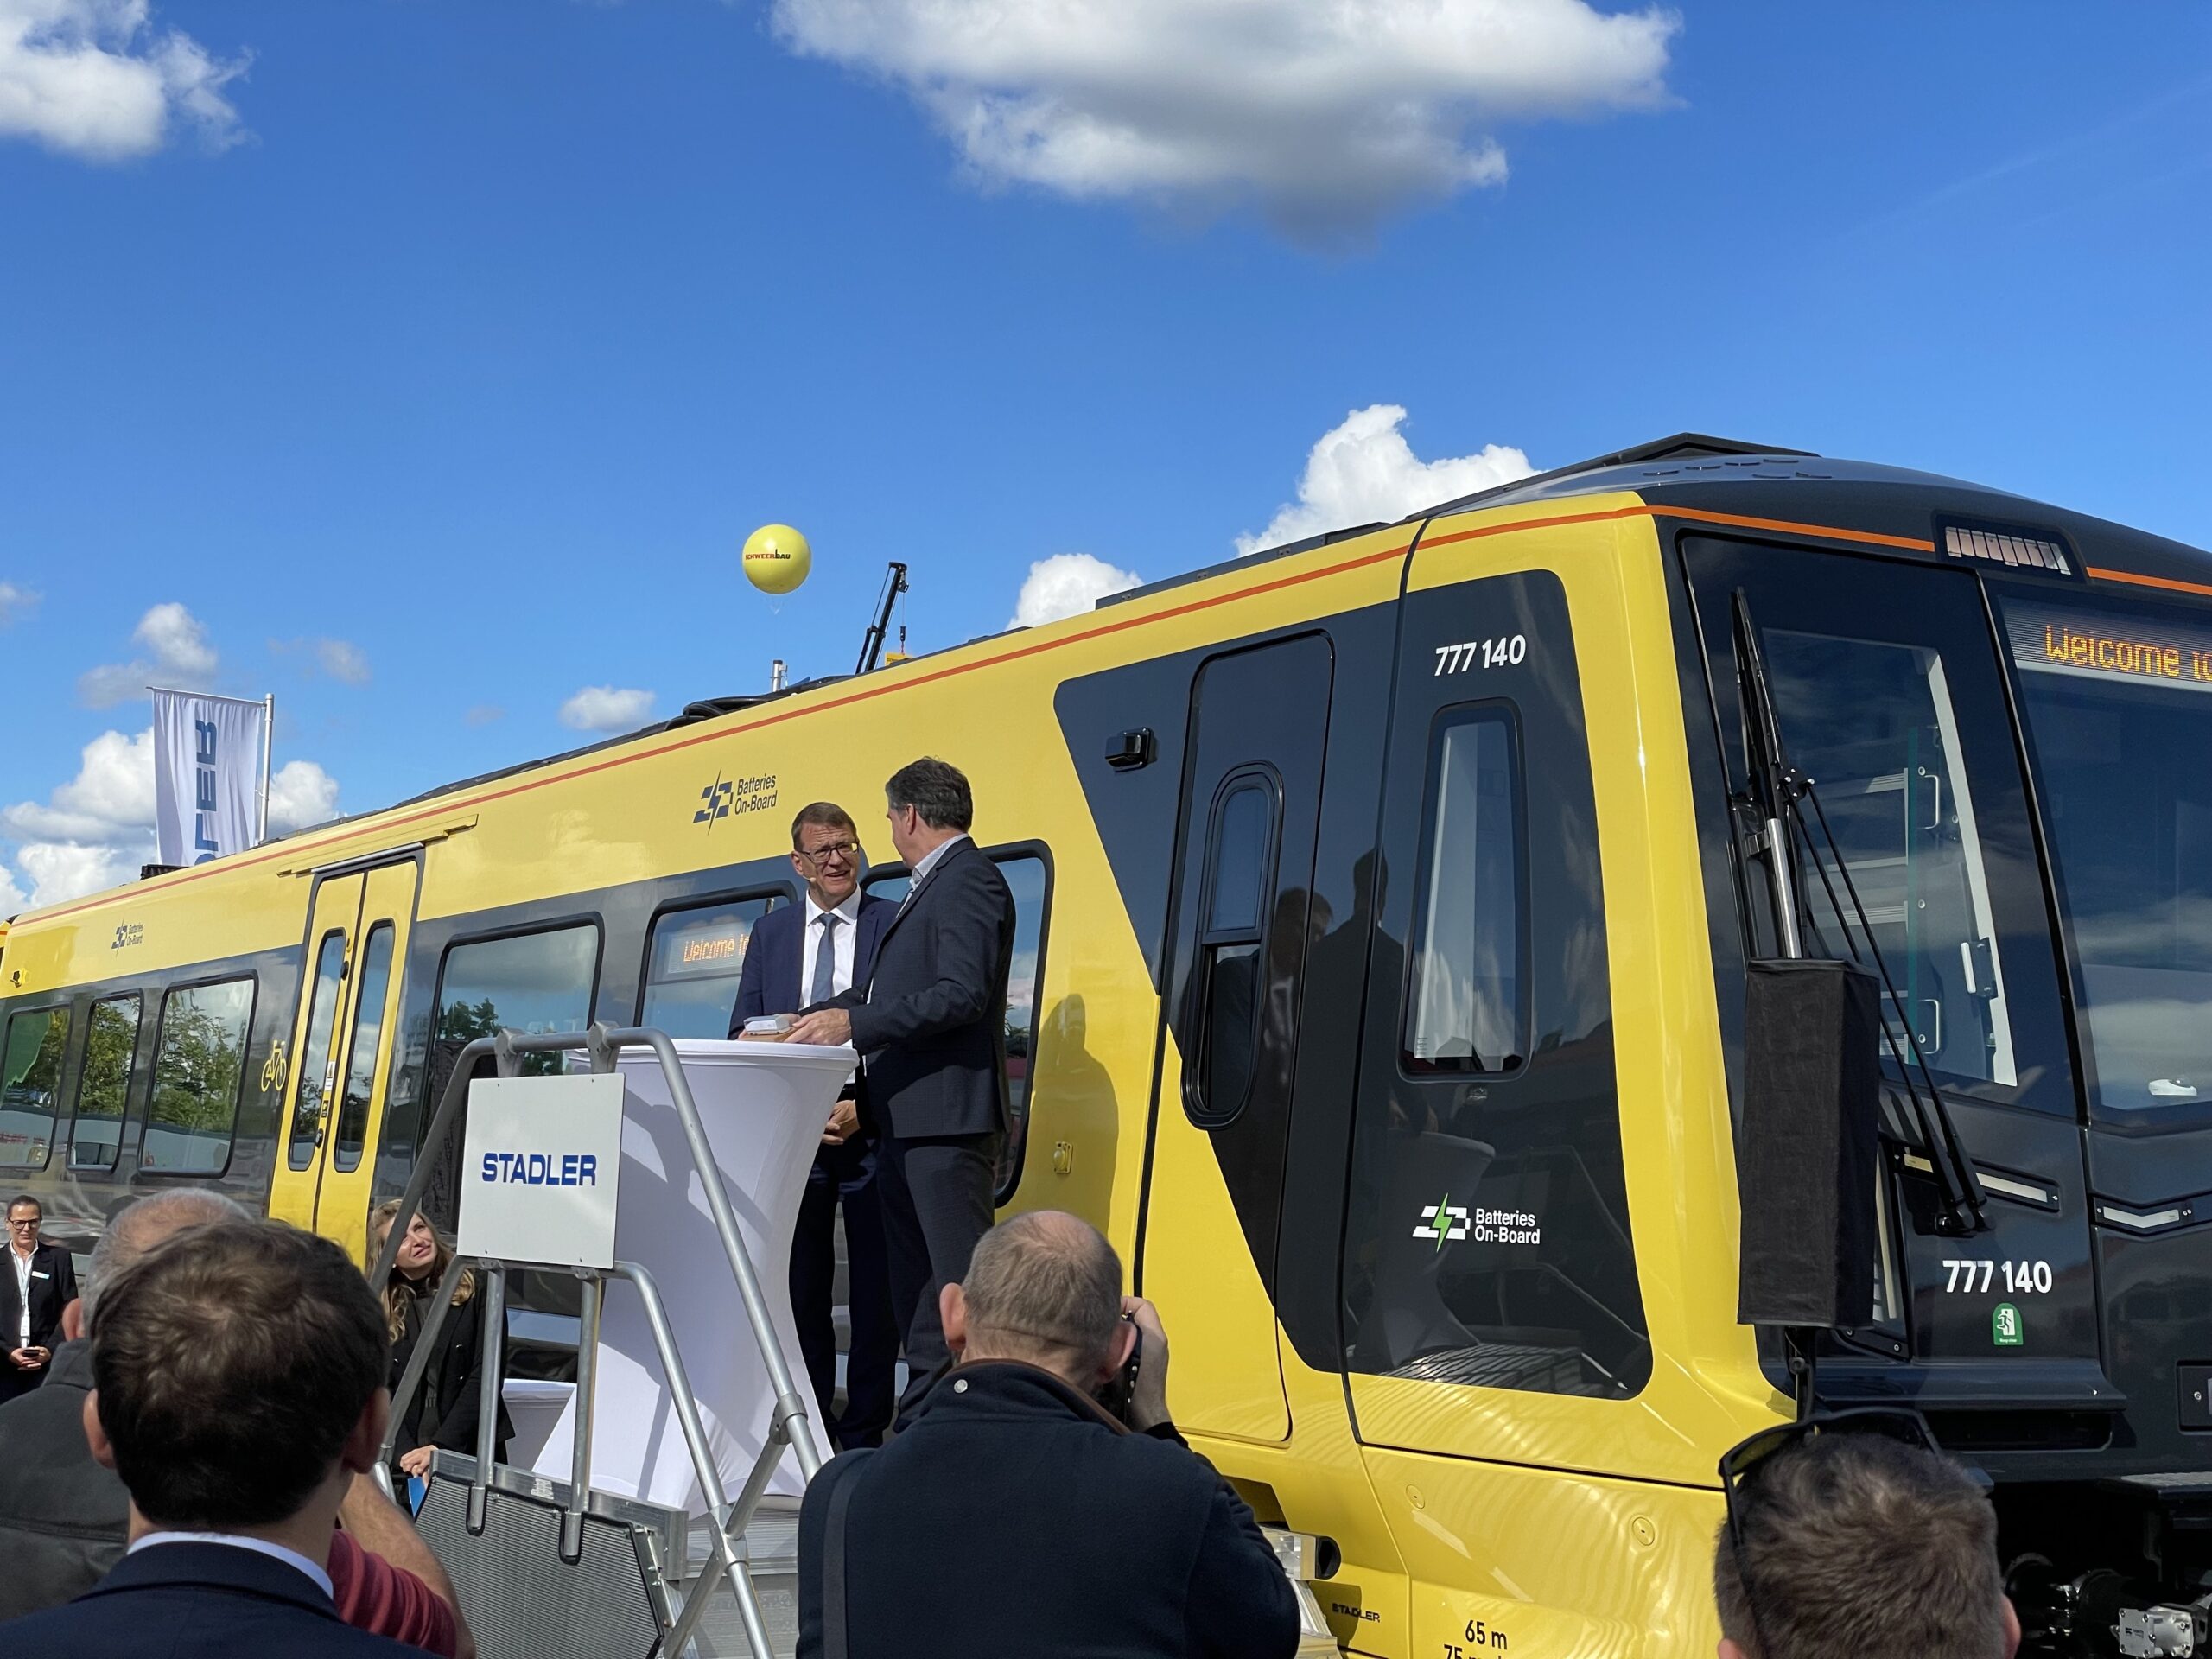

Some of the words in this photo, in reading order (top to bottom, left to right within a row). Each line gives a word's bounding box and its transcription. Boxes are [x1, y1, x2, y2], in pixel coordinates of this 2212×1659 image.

[1434, 642, 1477, 677] 777
[1482, 634, 1526, 669] 140
[2045, 625, 2181, 677] Welcome
[736, 772, 777, 796] Batteries
[734, 790, 778, 815] On-Board
[481, 1152, 597, 1186] STADLER
[1476, 1208, 1535, 1227] Batteries
[1474, 1224, 1541, 1244] On-Board
[1942, 1260, 1994, 1293] 777
[2001, 1260, 2053, 1294] 140
[1332, 1602, 1381, 1624] STADLER
[1465, 1619, 1486, 1645] 65
[1491, 1630, 1508, 1650] m
